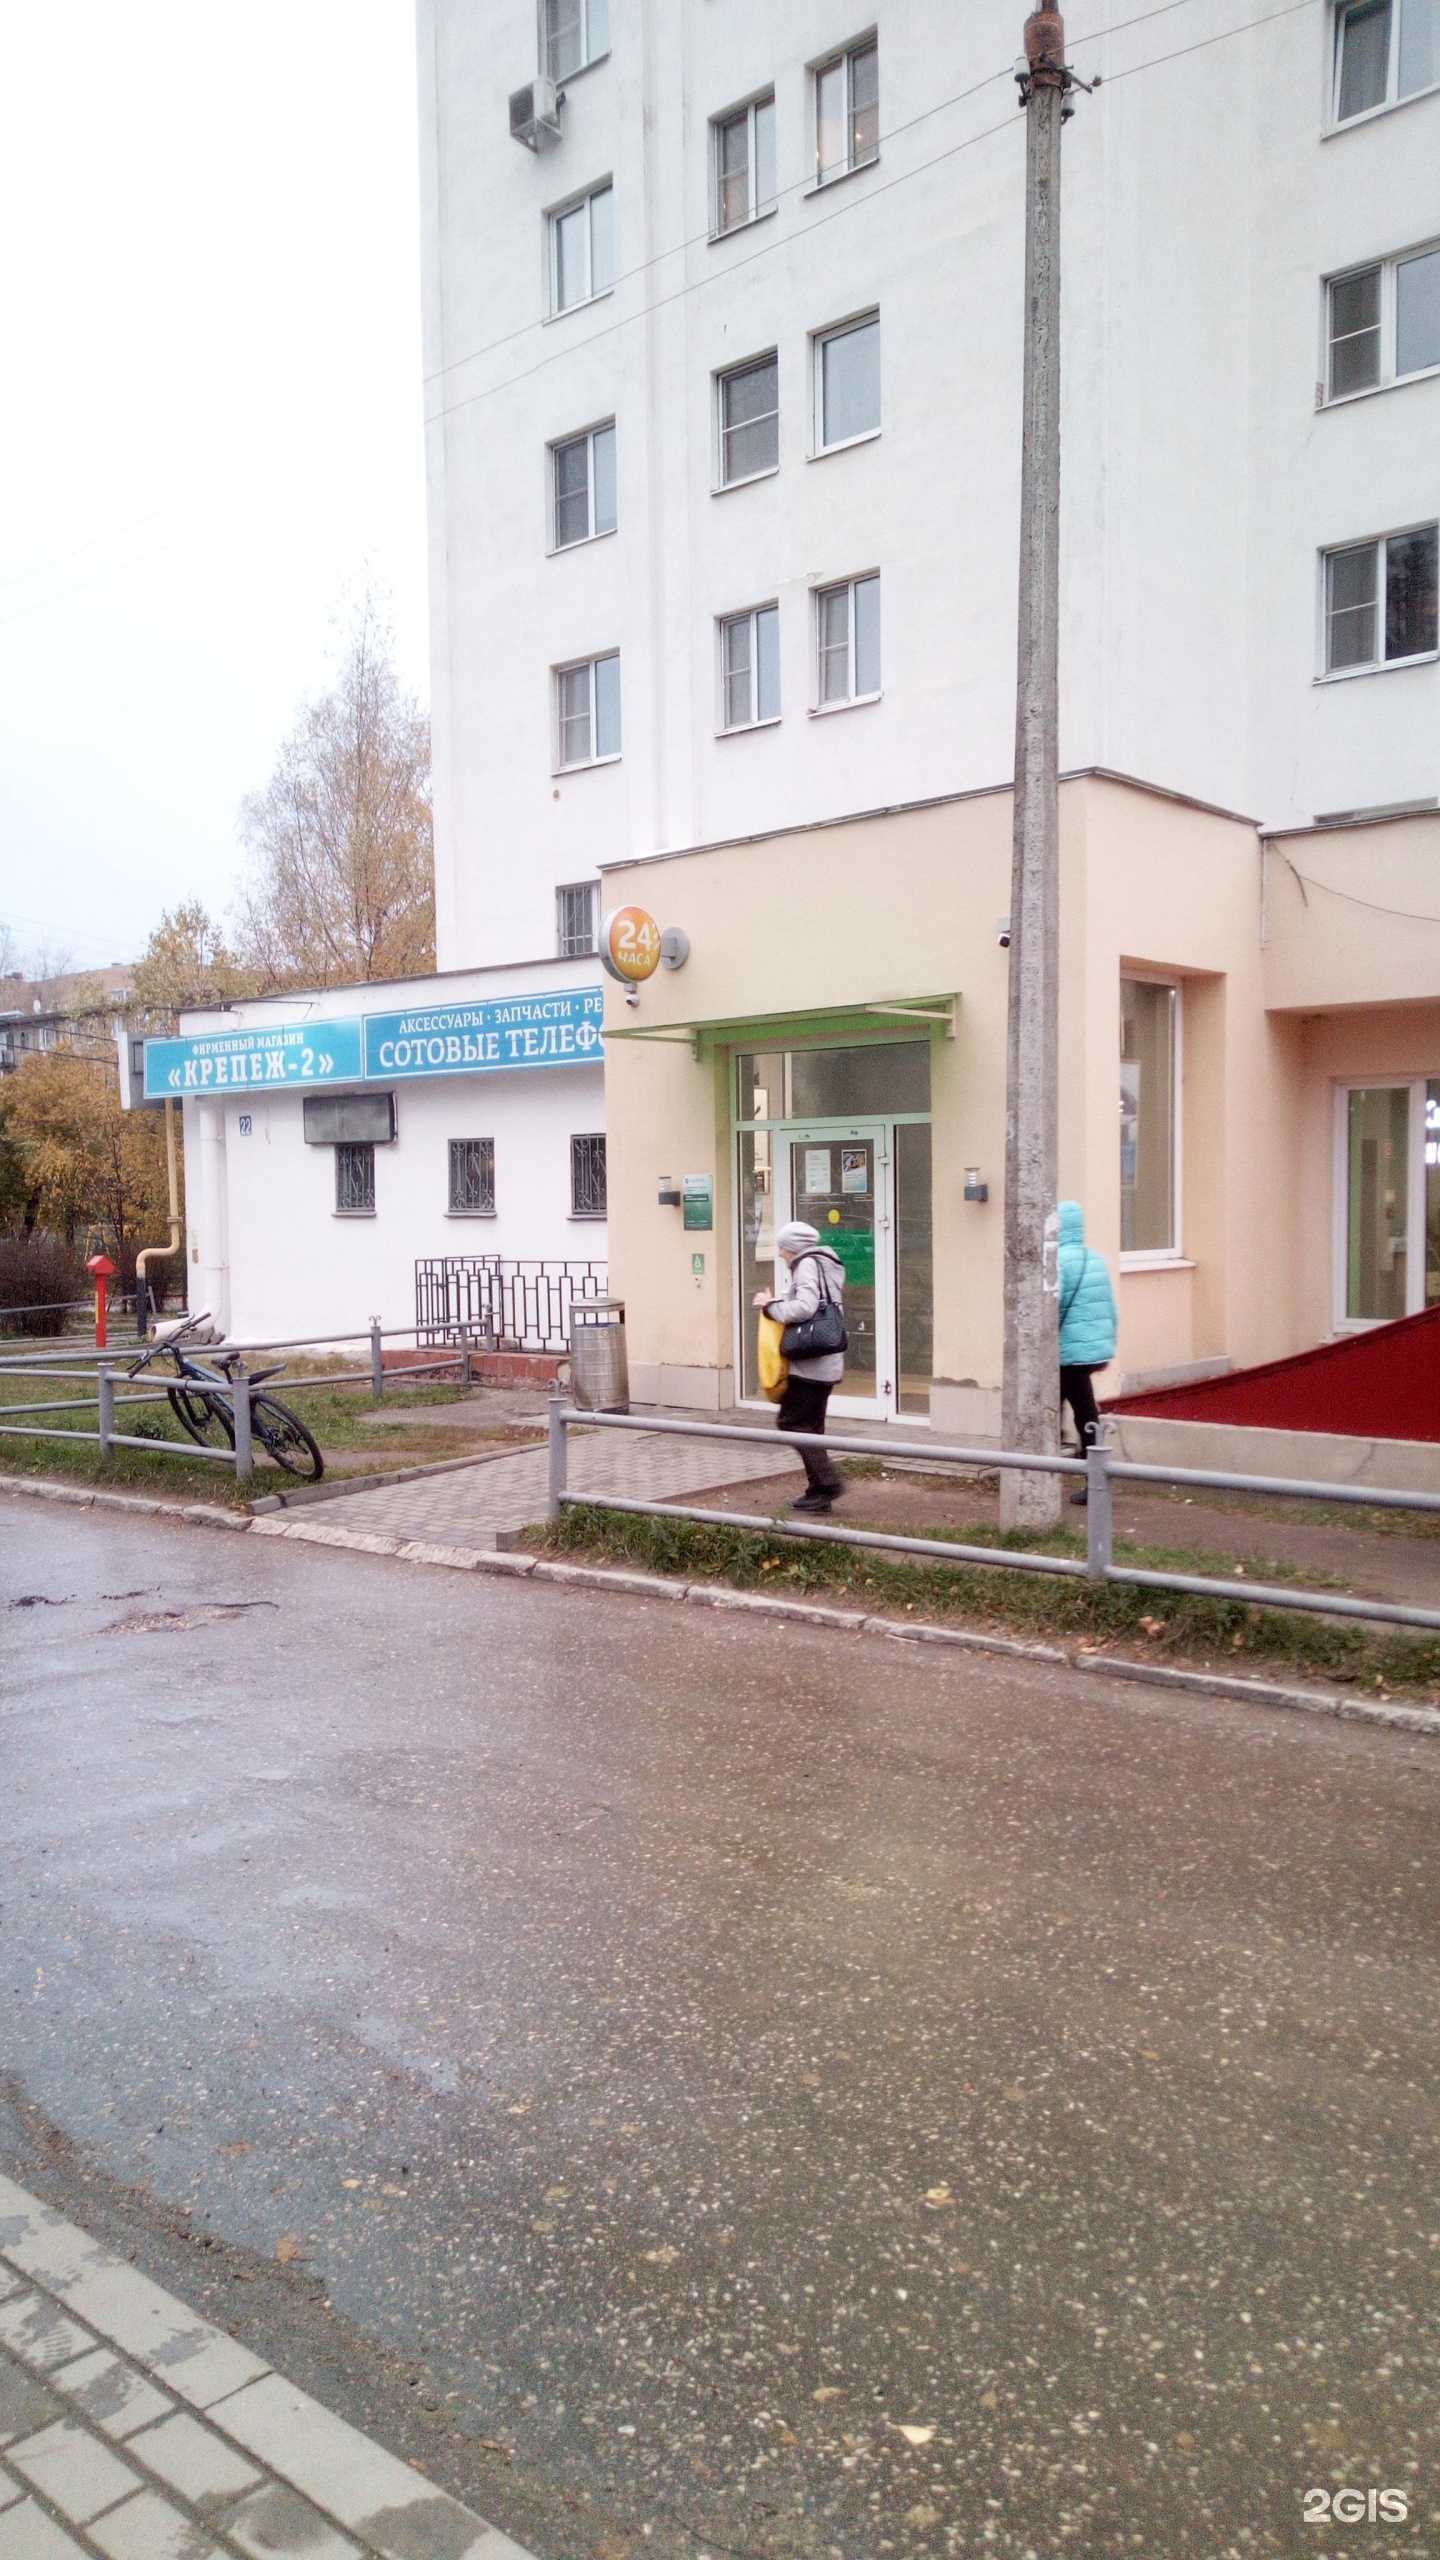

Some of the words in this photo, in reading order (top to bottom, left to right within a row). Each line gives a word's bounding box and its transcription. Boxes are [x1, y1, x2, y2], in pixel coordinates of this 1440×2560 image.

[617, 920, 652, 951] 24
[618, 951, 650, 966] ЧАСА
[399, 1011, 484, 1034] АКСЕССУАРЫ
[495, 1001, 571, 1024] ЗАПЧАСТИ
[192, 1036, 255, 1055] ФИРМЕННЫЙ
[256, 1032, 304, 1048] МАГАЗИН
[379, 1032, 500, 1068] СОТОВЫЕ
[505, 1021, 605, 1057] ТЕЛЕФ
[168, 1048, 334, 1088] «КРЕПЕЖ-2»
